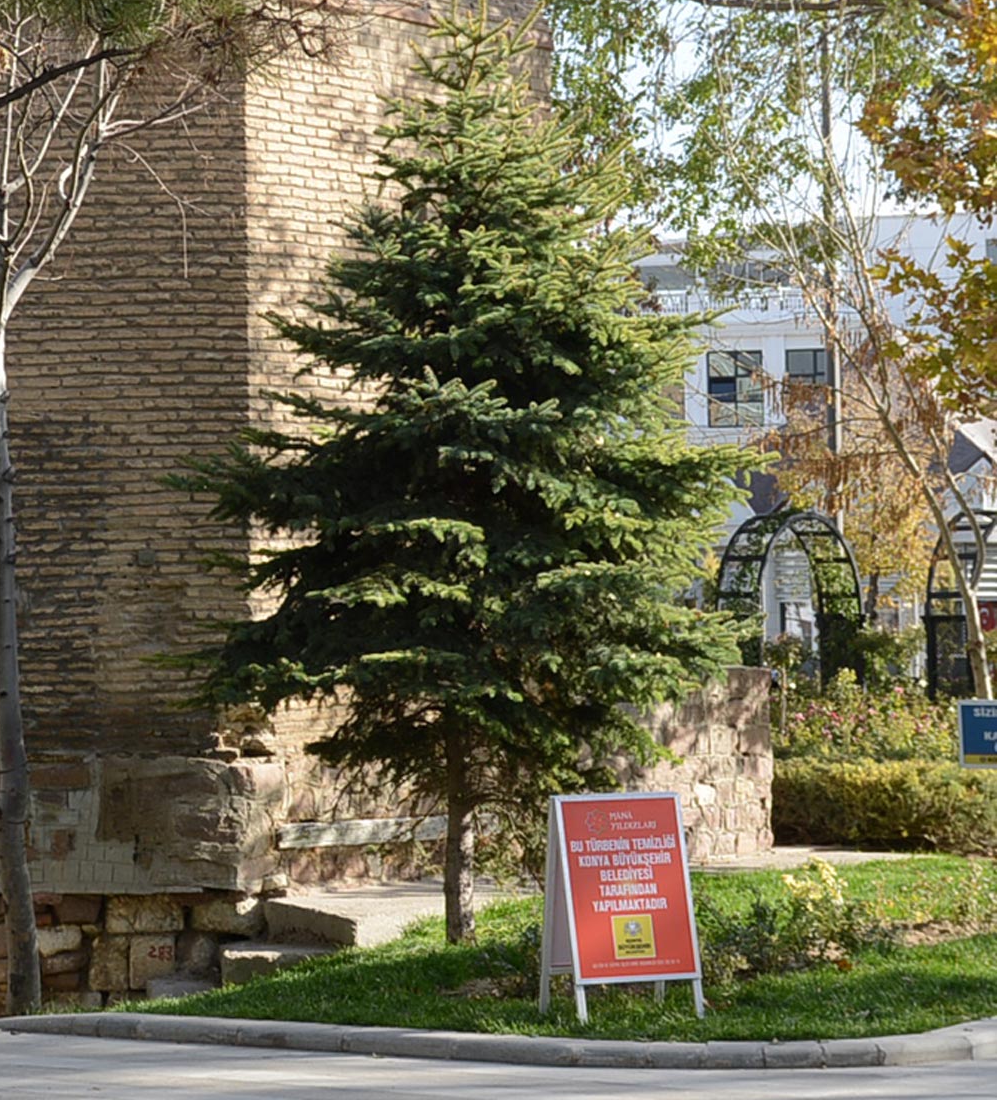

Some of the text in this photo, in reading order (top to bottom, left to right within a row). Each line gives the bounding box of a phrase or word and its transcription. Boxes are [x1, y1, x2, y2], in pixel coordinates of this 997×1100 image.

[570, 834, 676, 852] BU TÜRBENİN TEMİZLİĞİ
[578, 850, 671, 867] KONYA BÜYÜKŞEHİR
[600, 866, 654, 882] BELEDİYESİ
[599, 883, 658, 897] TARAFINDAN
[592, 897, 668, 912] YAPILMAKTADIR
